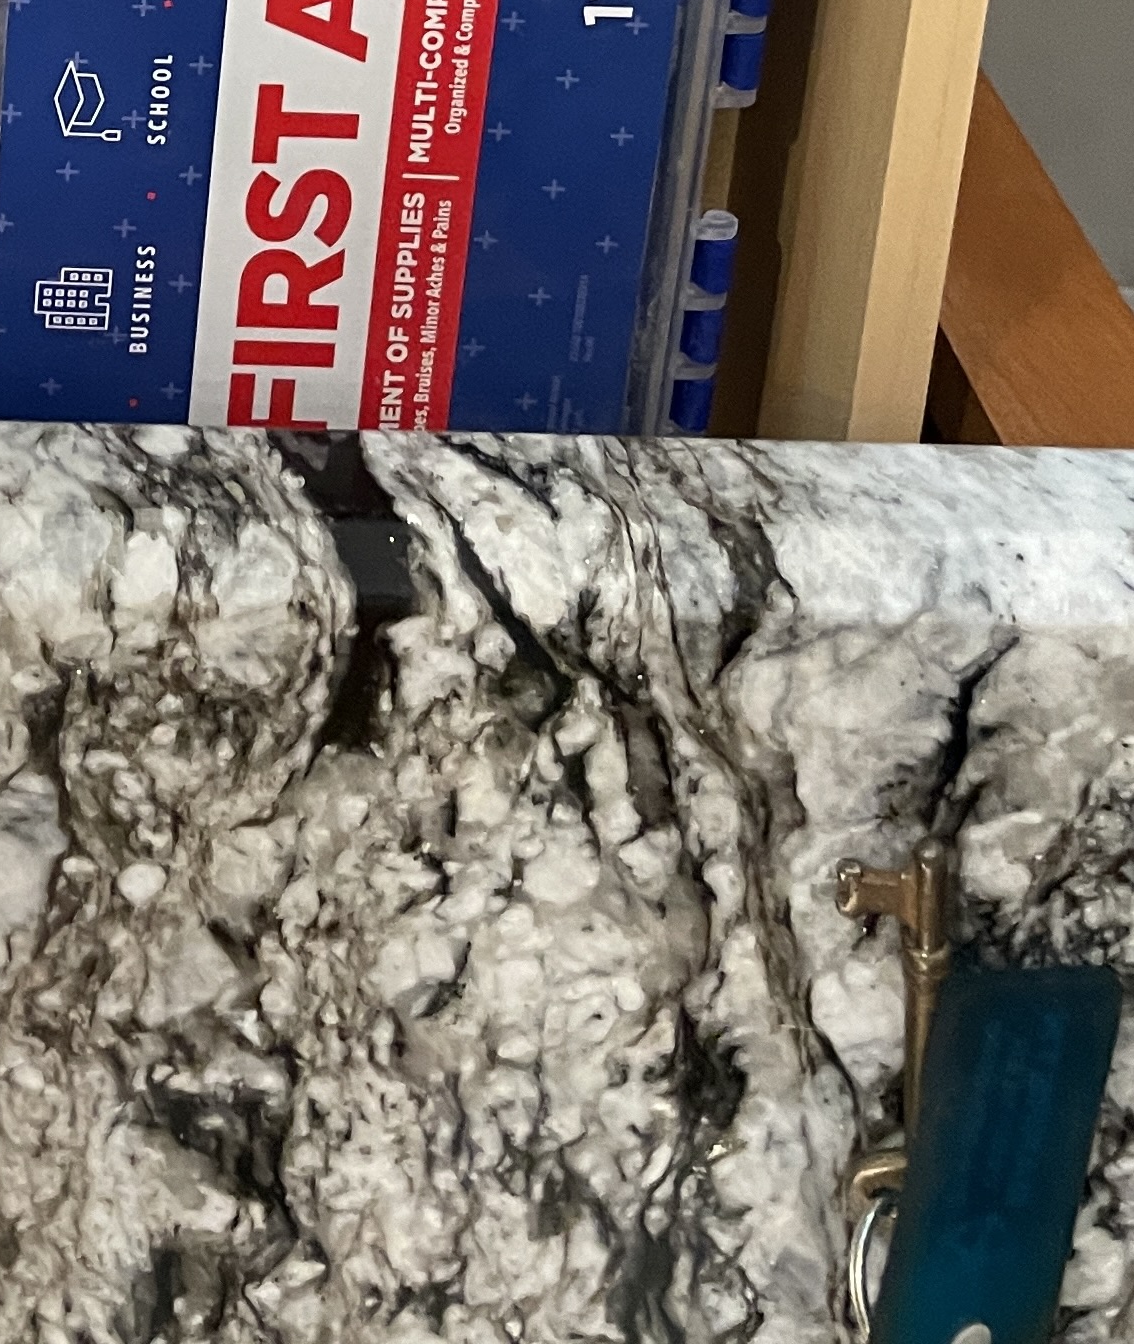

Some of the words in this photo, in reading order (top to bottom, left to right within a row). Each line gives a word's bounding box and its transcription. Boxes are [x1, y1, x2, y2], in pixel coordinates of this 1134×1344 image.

[453, 44, 470, 56] &
[145, 54, 174, 146] SCHOOL
[443, 59, 470, 134] Organized
[433, 199, 453, 239] Pains
[226, 84, 360, 429] FIRST
[391, 192, 426, 320] SUPPLIES
[430, 242, 448, 254] &
[127, 244, 156, 354] BUSINESS
[425, 256, 446, 298] Aches
[386, 325, 409, 363] OF
[420, 301, 441, 343] Minor
[413, 347, 437, 403] Bruises,
